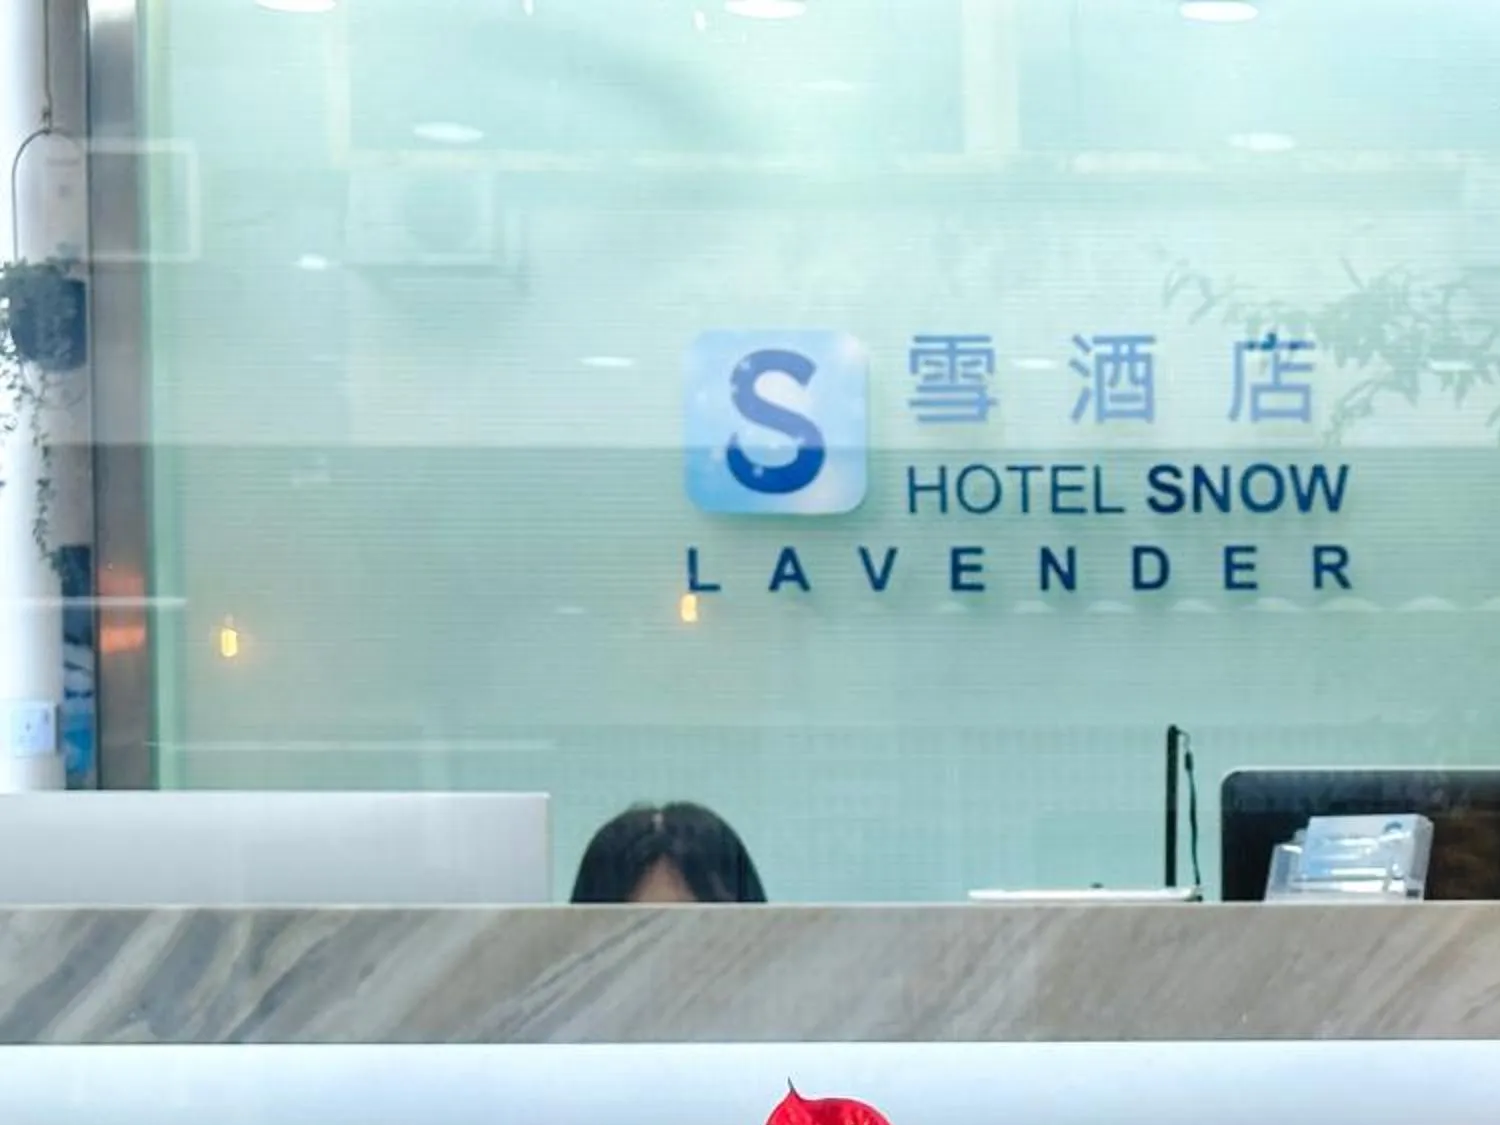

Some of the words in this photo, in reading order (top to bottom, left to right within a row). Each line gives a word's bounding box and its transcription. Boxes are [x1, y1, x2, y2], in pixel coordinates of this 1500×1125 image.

[908, 333, 1315, 424] 雪酒店
[725, 349, 826, 494] S
[907, 465, 1124, 514] HOTEL
[1145, 464, 1349, 514] SNOW
[687, 546, 1353, 592] LAVENDER
